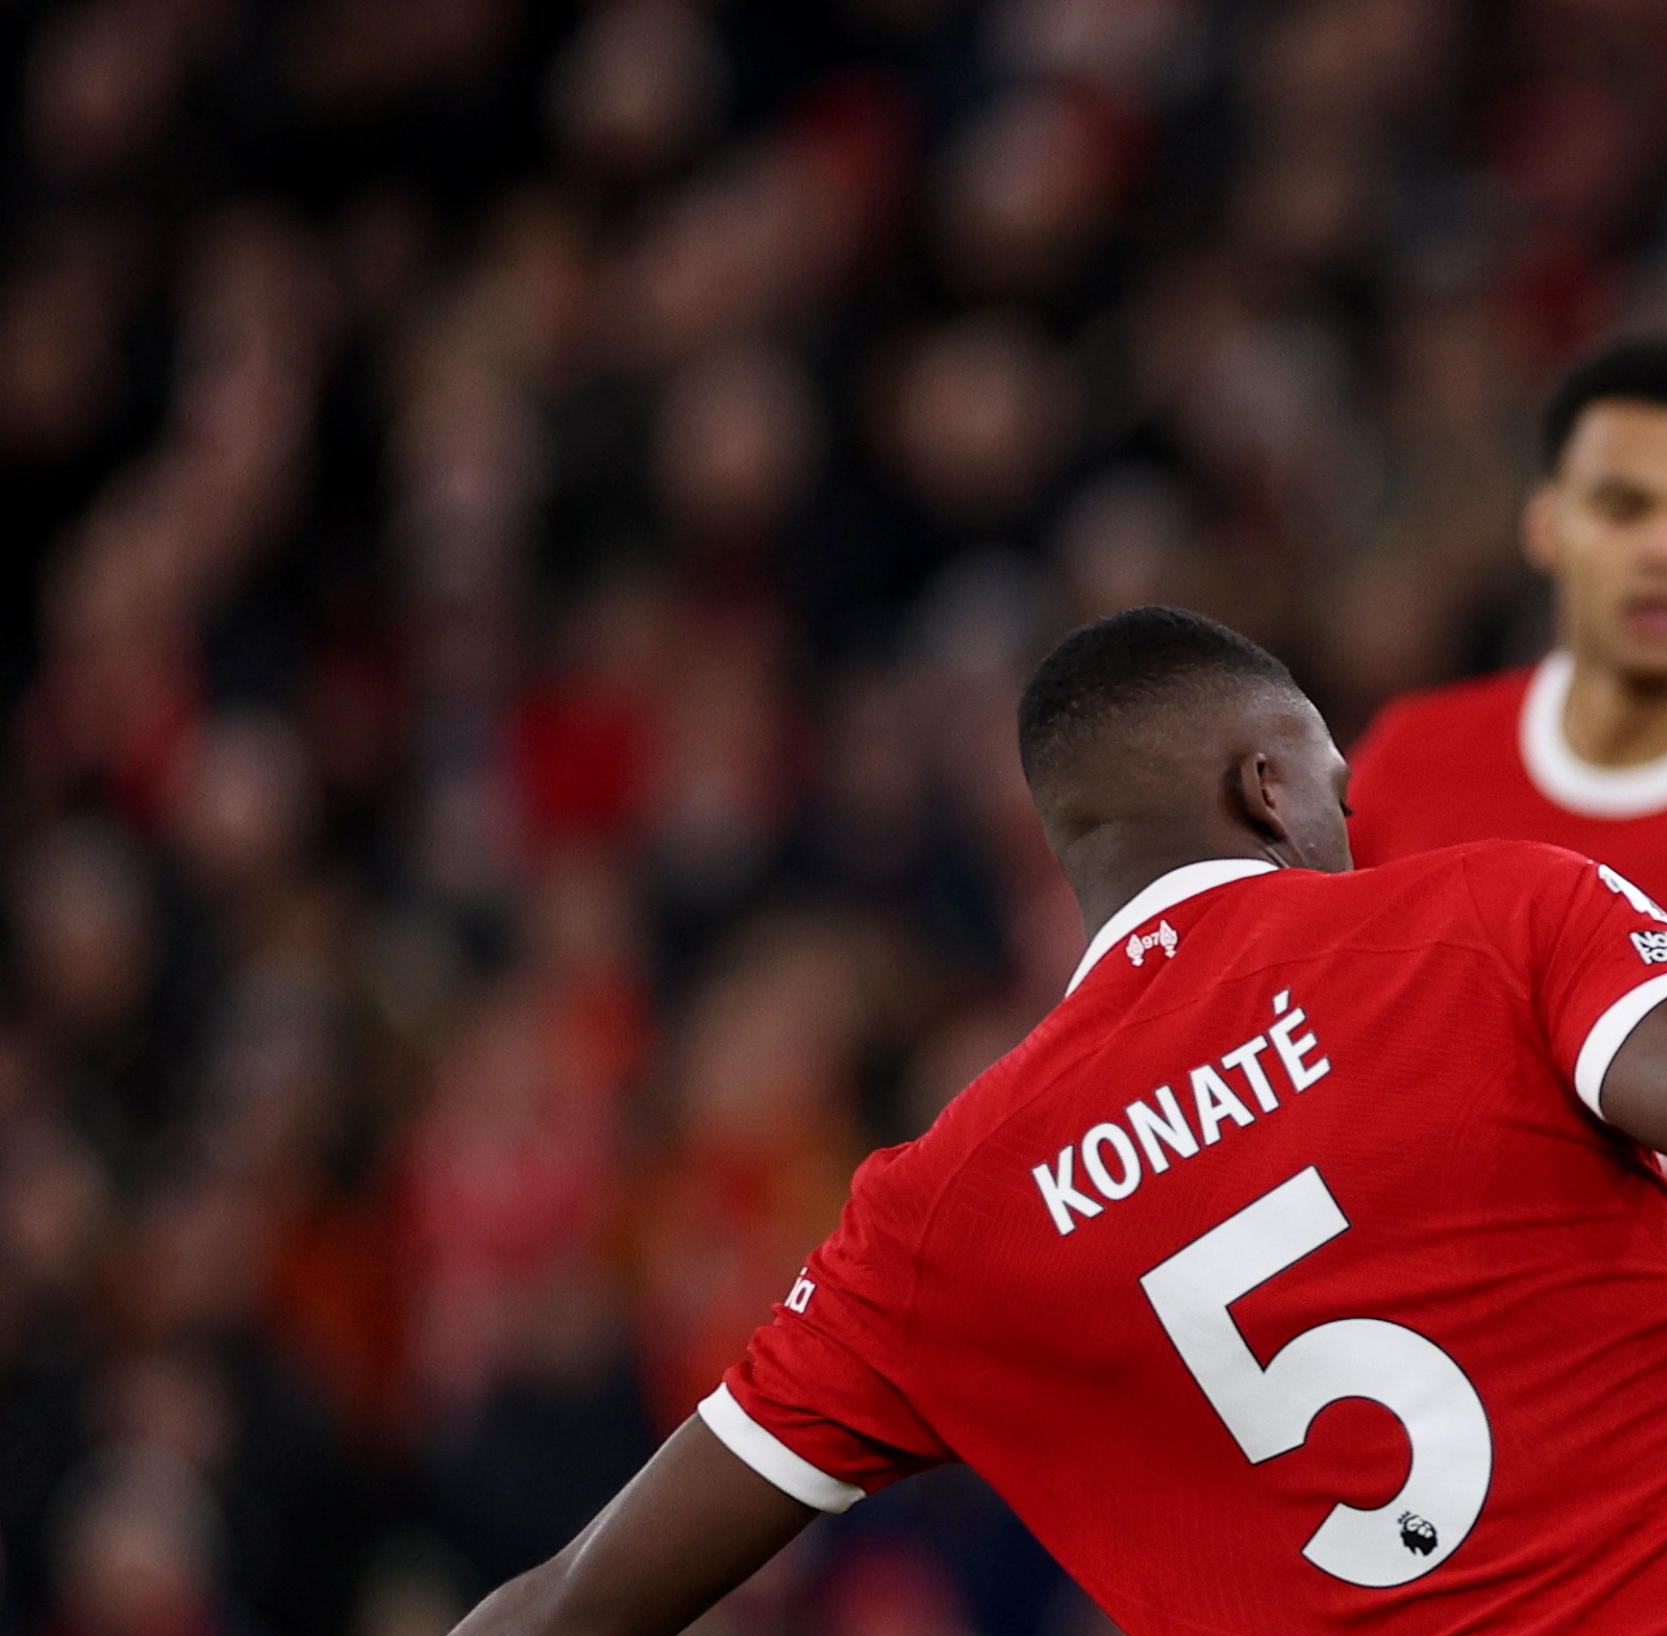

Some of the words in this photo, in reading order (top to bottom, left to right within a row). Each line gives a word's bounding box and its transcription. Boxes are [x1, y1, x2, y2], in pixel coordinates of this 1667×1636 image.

[1141, 931, 1161, 950] 97
[1032, 990, 1331, 1236] KONATÉ
[1139, 1164, 1492, 1588] 5
